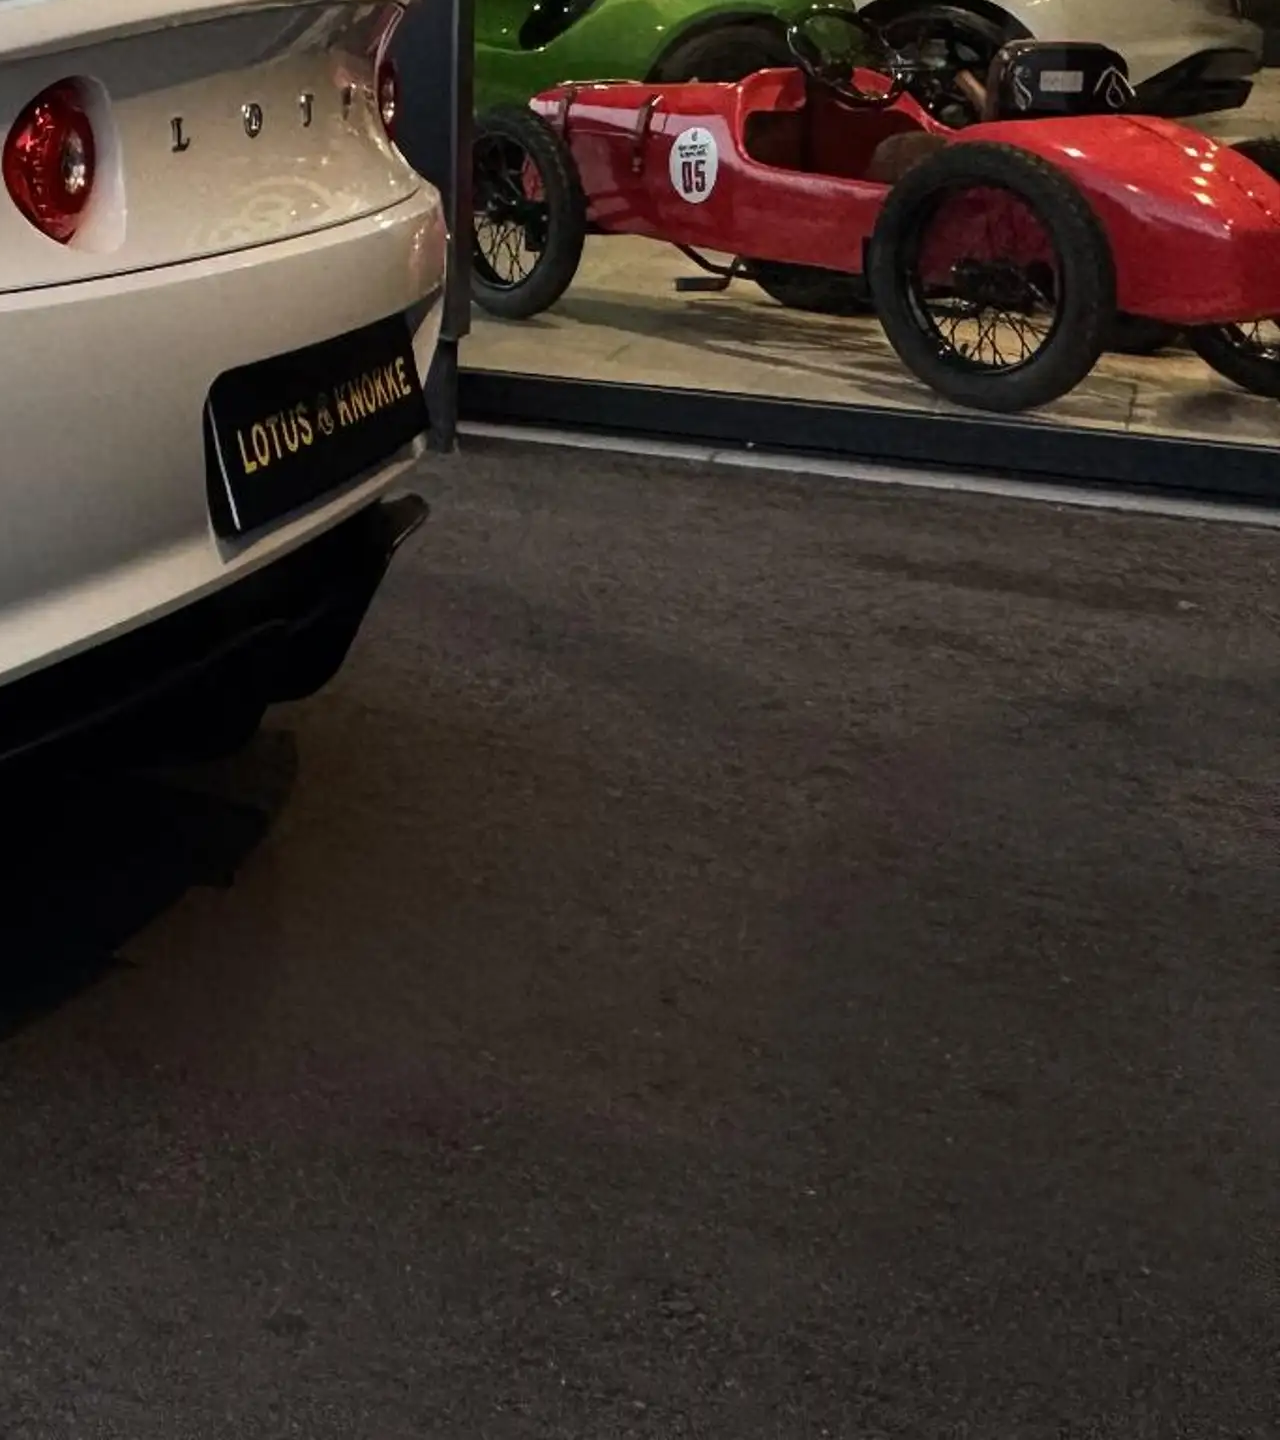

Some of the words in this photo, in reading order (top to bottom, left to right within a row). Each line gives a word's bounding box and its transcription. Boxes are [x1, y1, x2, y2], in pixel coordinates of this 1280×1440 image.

[681, 160, 706, 194] 05
[237, 401, 313, 475] LOTUS
[335, 356, 412, 427] KNOKKE
